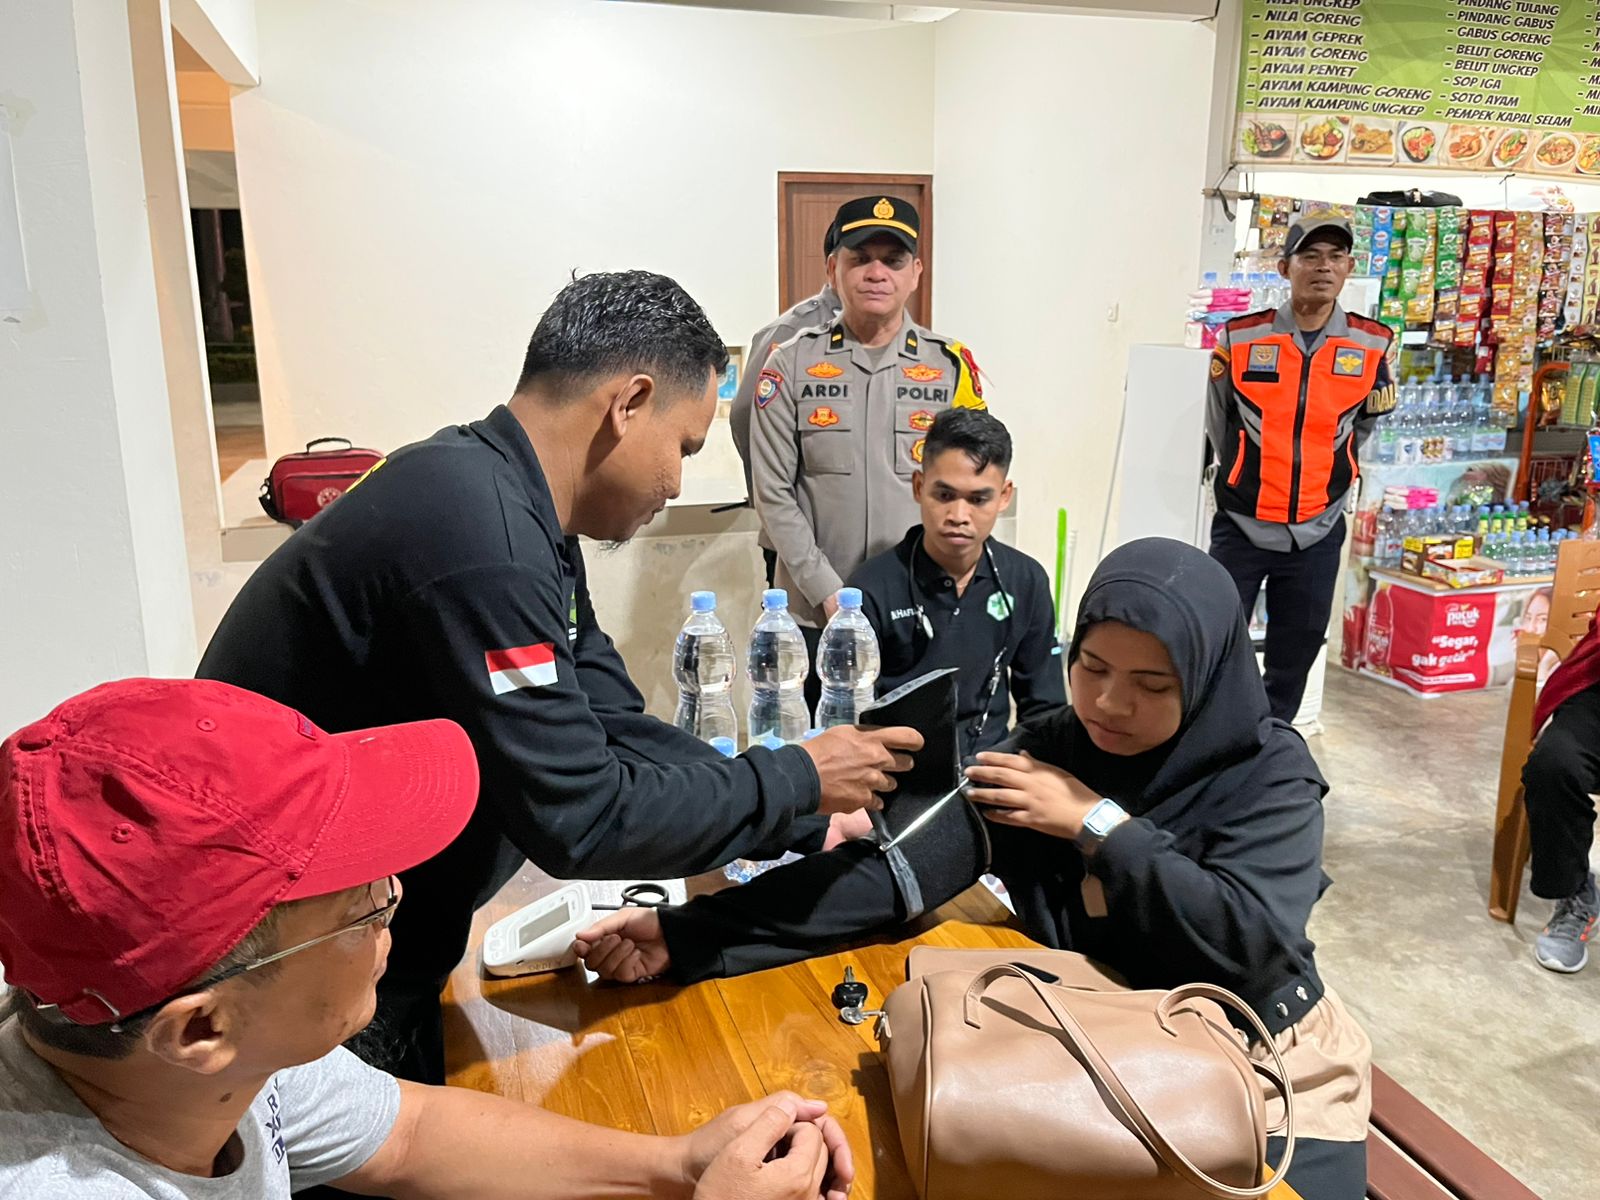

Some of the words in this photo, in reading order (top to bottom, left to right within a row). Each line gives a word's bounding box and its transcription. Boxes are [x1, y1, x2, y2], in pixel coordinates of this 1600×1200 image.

[1515, 2, 1559, 15] TULANG
[1265, 10, 1298, 22] NILA
[1303, 12, 1361, 26] GORENG
[1457, 11, 1511, 26] PINDANG
[1514, 17, 1555, 29] GABUS
[1263, 29, 1308, 41] AYAM
[1312, 31, 1364, 45] GEPREK
[1457, 27, 1498, 40] GABUS
[1501, 31, 1551, 45] GORENG
[1262, 46, 1305, 57] AYAM
[1310, 47, 1368, 61] GORENG
[1456, 45, 1491, 57] BELUT
[1493, 48, 1543, 62] GORENG
[1261, 63, 1305, 75] AYAM
[1308, 64, 1357, 78] PENYET
[1454, 59, 1489, 72] BELUT
[1492, 63, 1539, 77] UNGKEP
[1259, 80, 1303, 91] AYAM
[1306, 81, 1372, 95] KAMPUNG
[1374, 86, 1432, 100] GORENG
[1452, 76, 1478, 87] SOP
[1480, 78, 1502, 90] IGA
[1258, 97, 1301, 108] AYAM
[1304, 98, 1369, 112] KAMPUNG
[1372, 102, 1424, 116] UNGKEP
[1449, 92, 1483, 104] SOTO
[1485, 95, 1519, 107] AYAM
[1445, 108, 1495, 121] PEMPEK
[1496, 112, 1532, 123] KAPAL
[1534, 115, 1573, 127] SELAM
[801, 384, 848, 398] ARDI
[896, 386, 948, 403] POLRI
